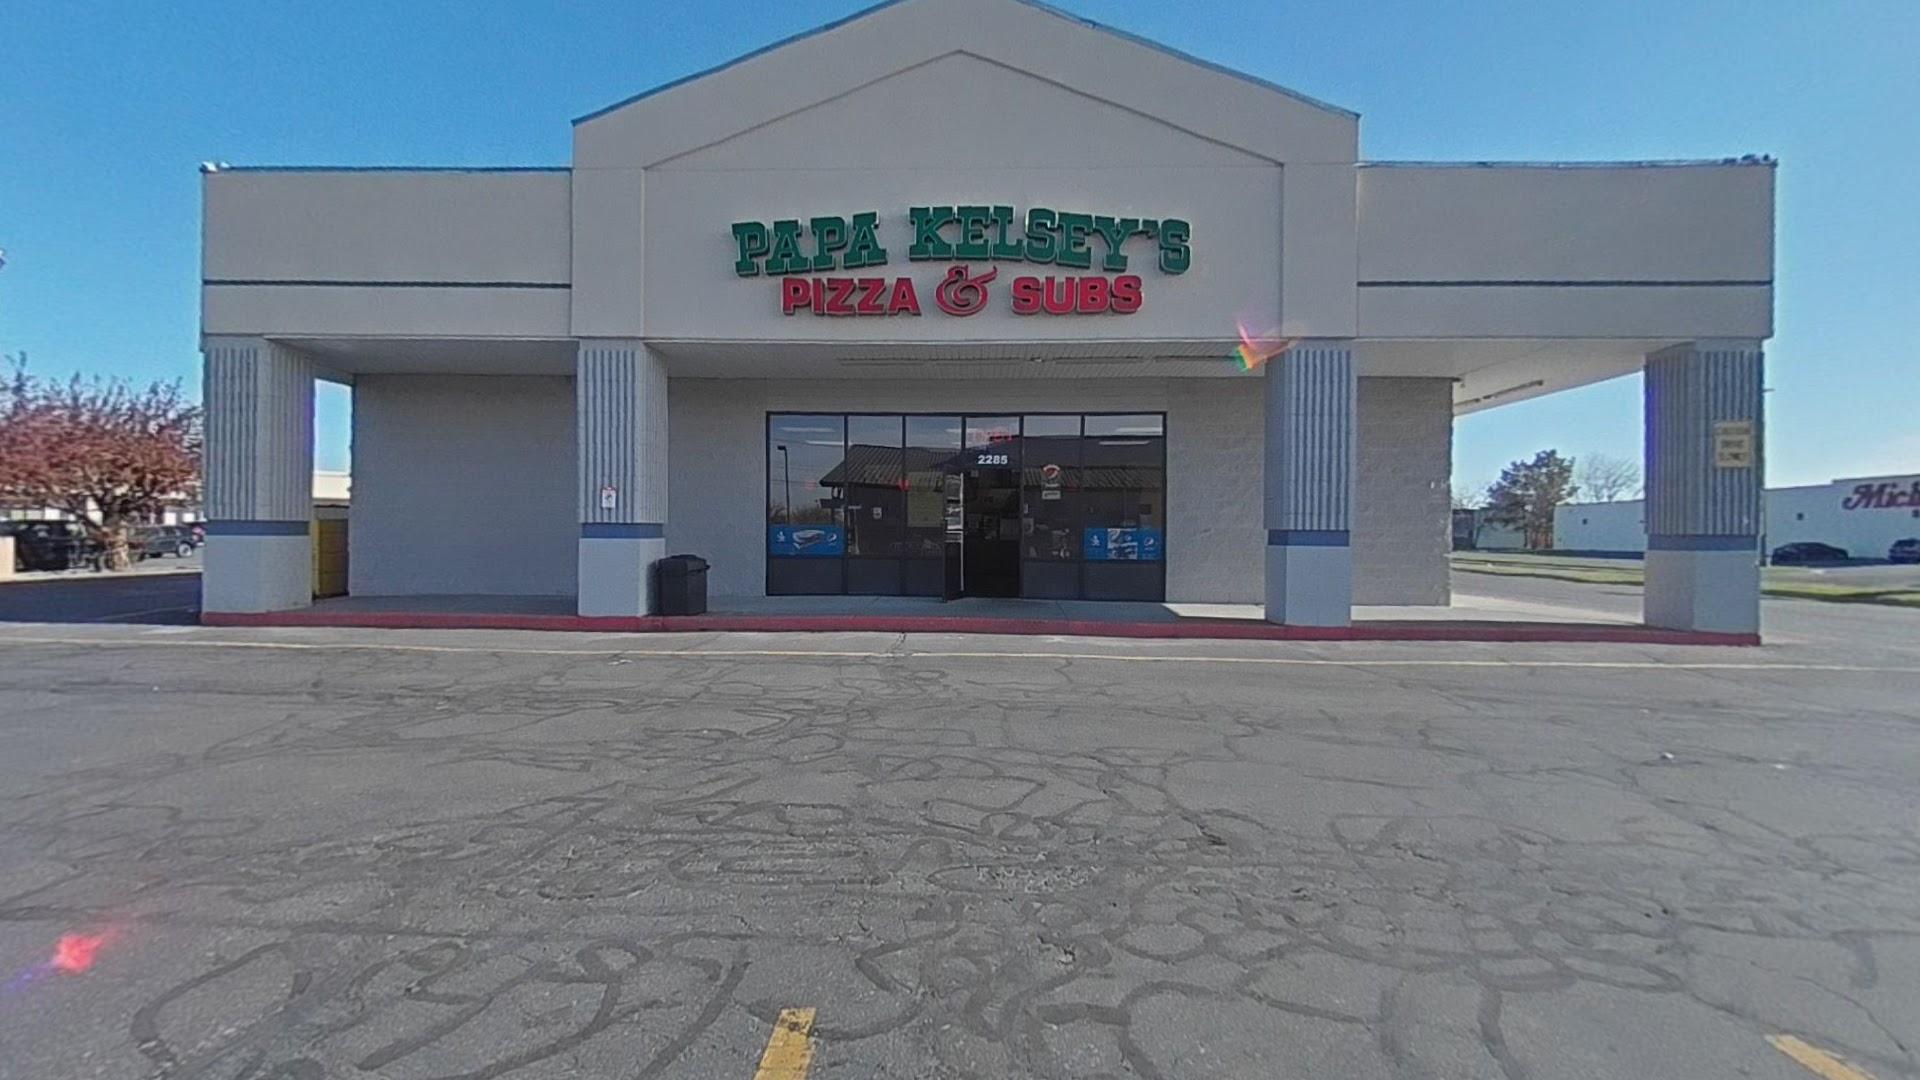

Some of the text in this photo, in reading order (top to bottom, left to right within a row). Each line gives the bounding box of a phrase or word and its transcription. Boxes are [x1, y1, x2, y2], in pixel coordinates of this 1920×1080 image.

[732, 206, 1191, 276] PAPA KELSEY'S
[782, 264, 1143, 317] PIZZA & SUBS
[977, 454, 1008, 465] 2285
